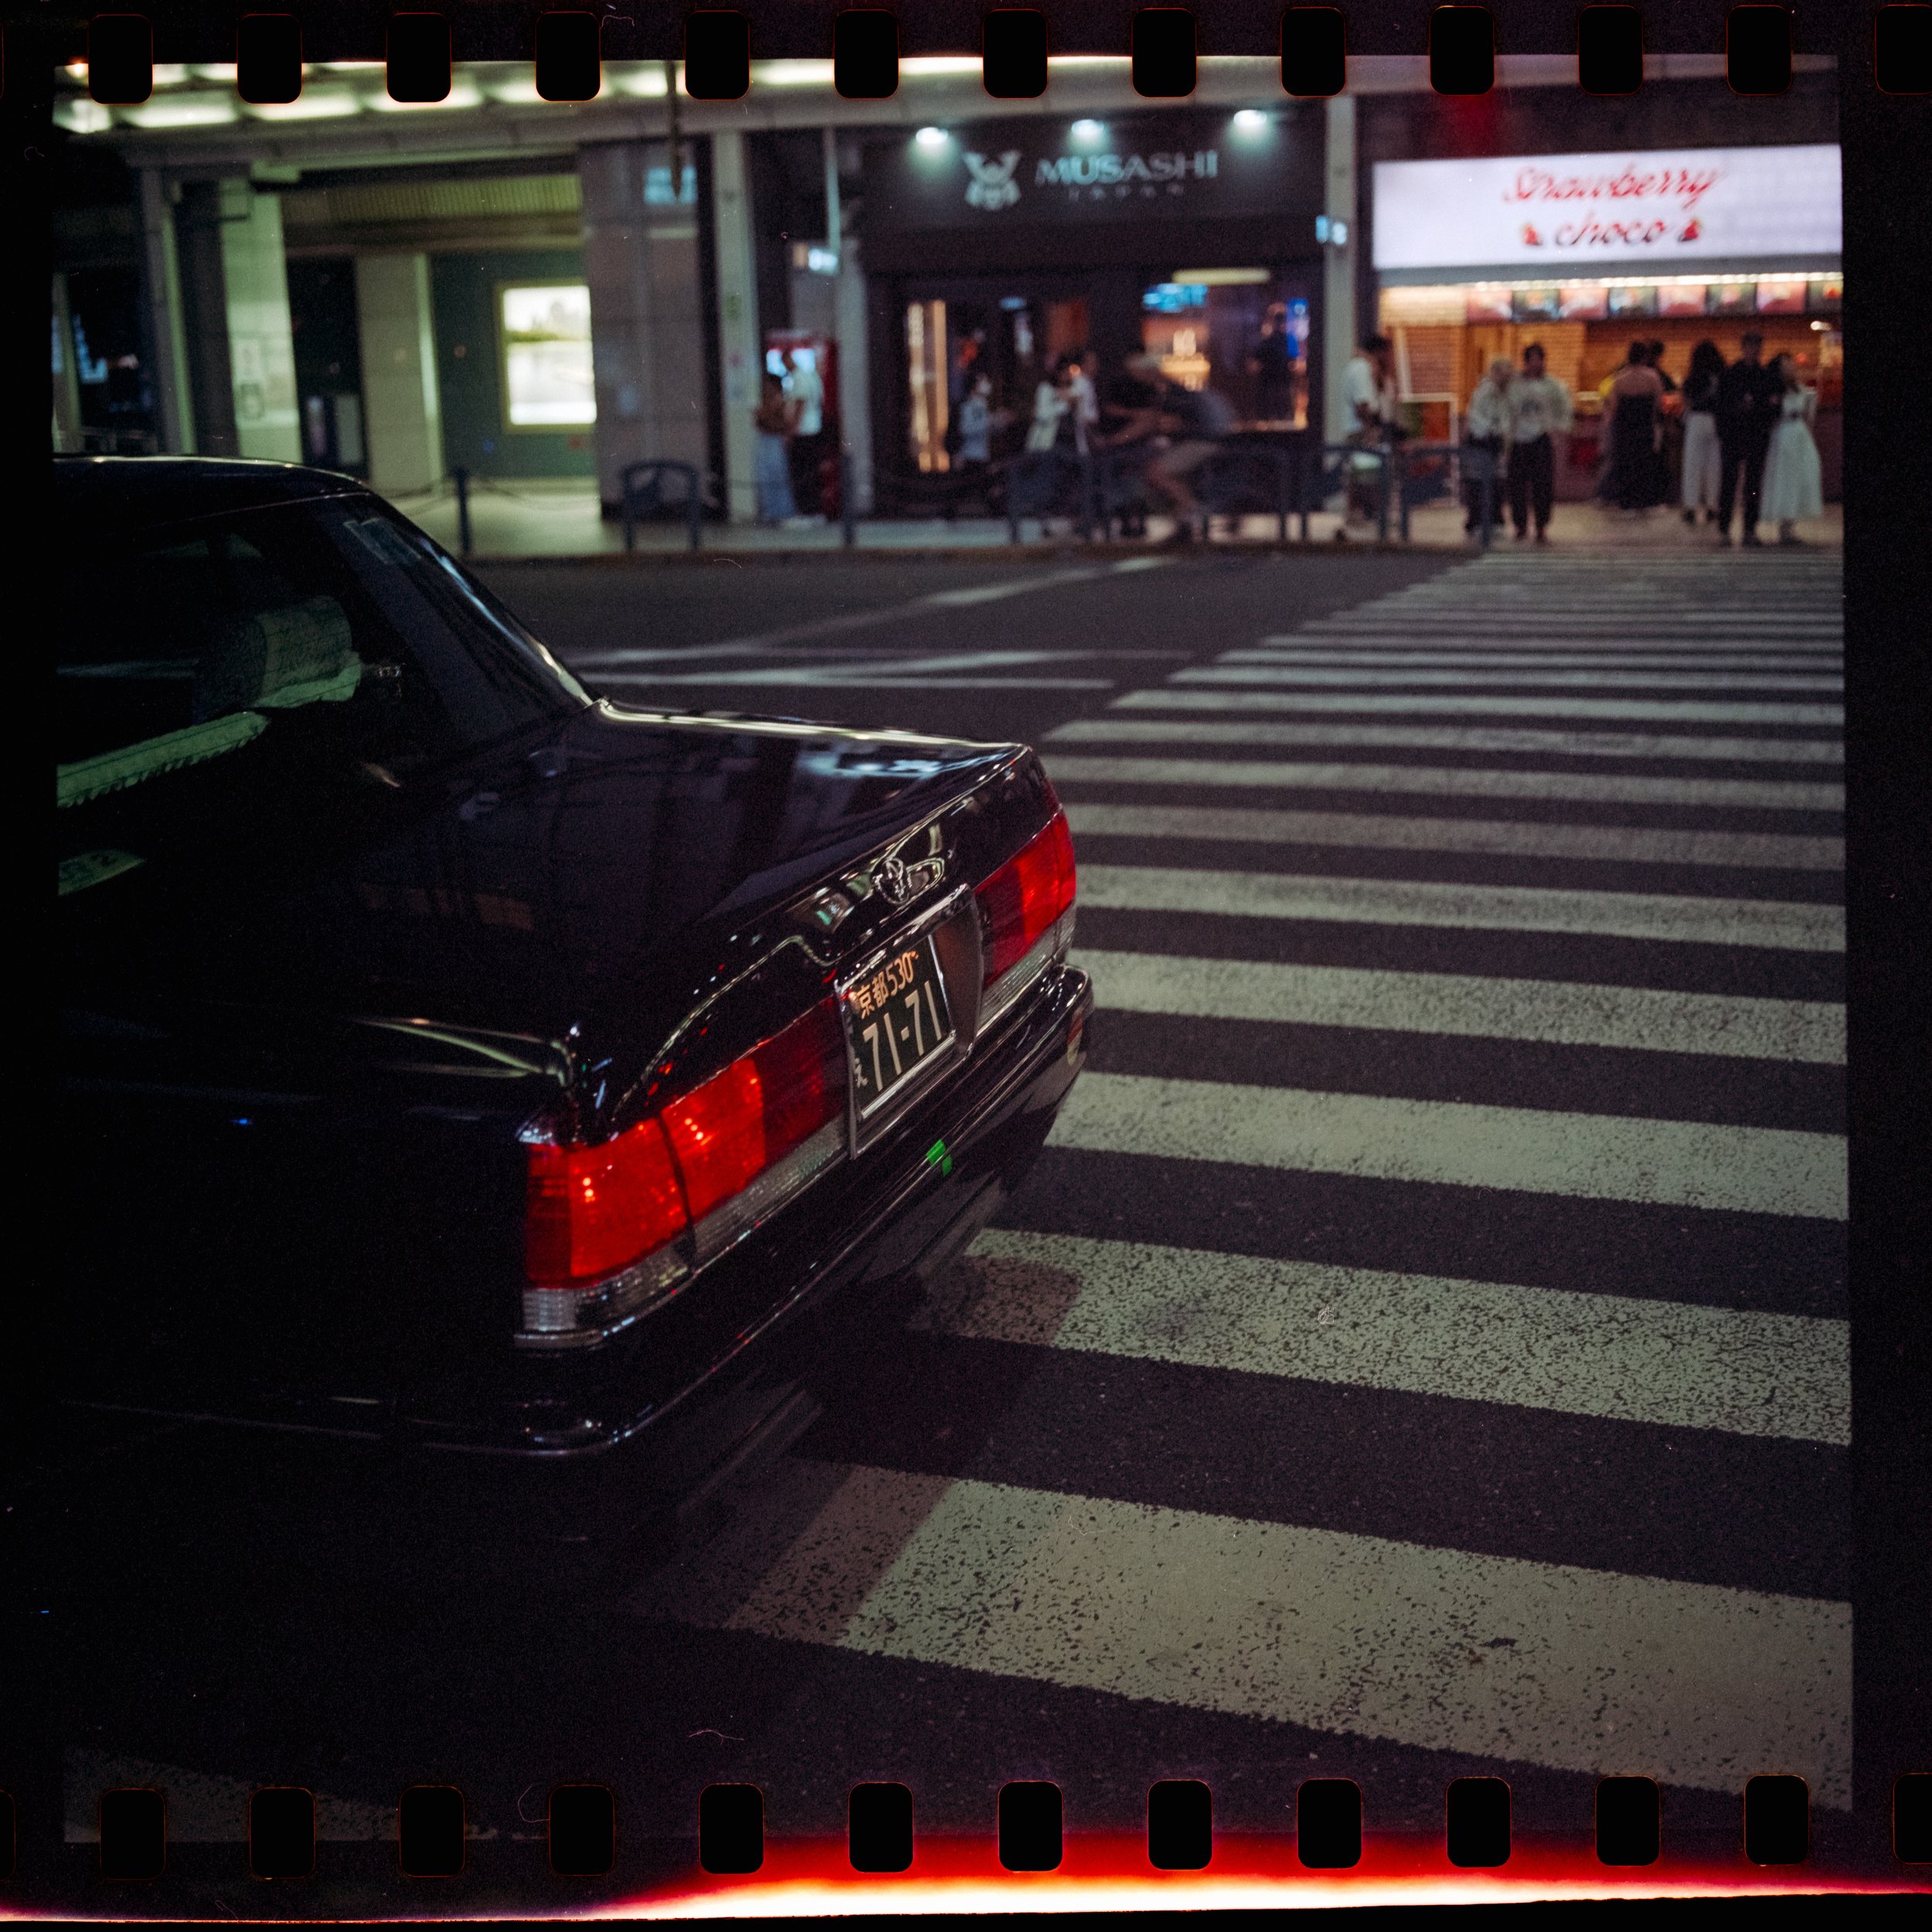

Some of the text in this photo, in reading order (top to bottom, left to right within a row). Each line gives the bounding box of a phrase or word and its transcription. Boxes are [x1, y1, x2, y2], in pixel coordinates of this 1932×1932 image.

[1034, 149, 1219, 186] MUSASHI
[1554, 209, 1667, 246] choco
[862, 981, 942, 1092] 71-71
